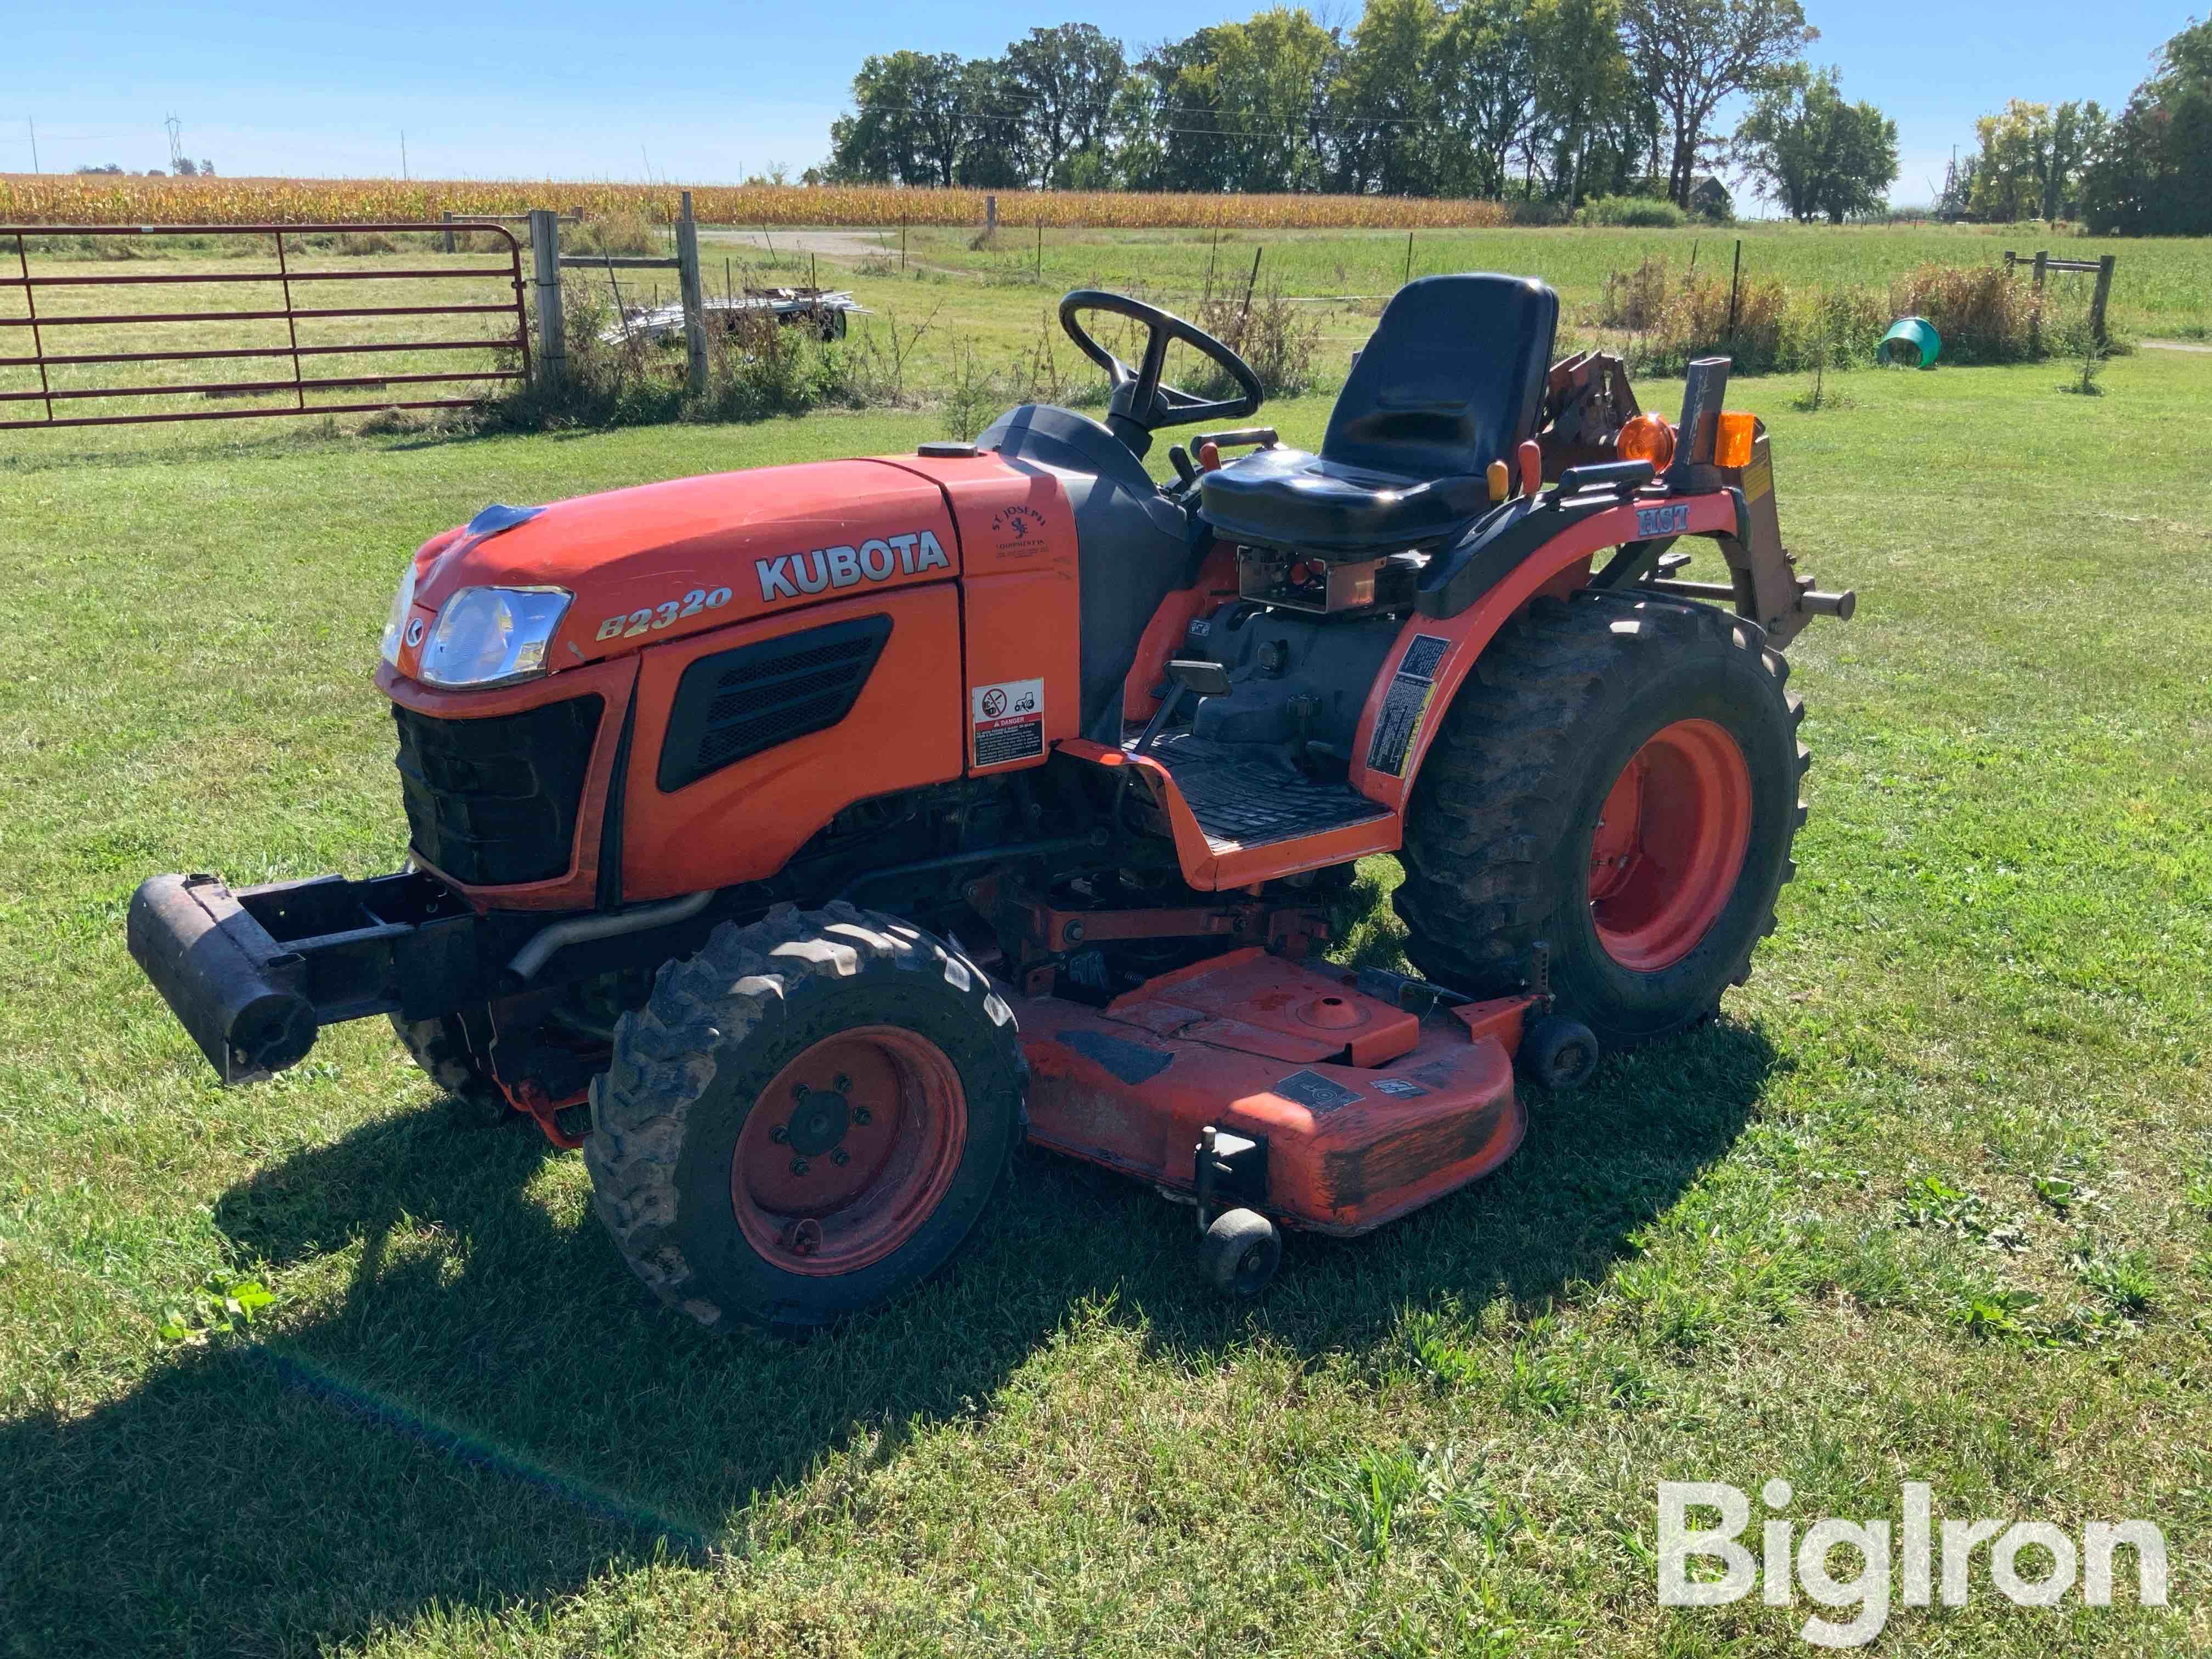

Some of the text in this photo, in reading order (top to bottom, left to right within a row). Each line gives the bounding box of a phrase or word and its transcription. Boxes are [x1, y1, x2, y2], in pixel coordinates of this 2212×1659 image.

[1003, 506, 1046, 527] JOSEPH
[1637, 504, 1690, 536] HST
[755, 529, 951, 602] KUBOTA
[595, 586, 732, 642] B2320
[1000, 716, 1025, 726] DANGER
